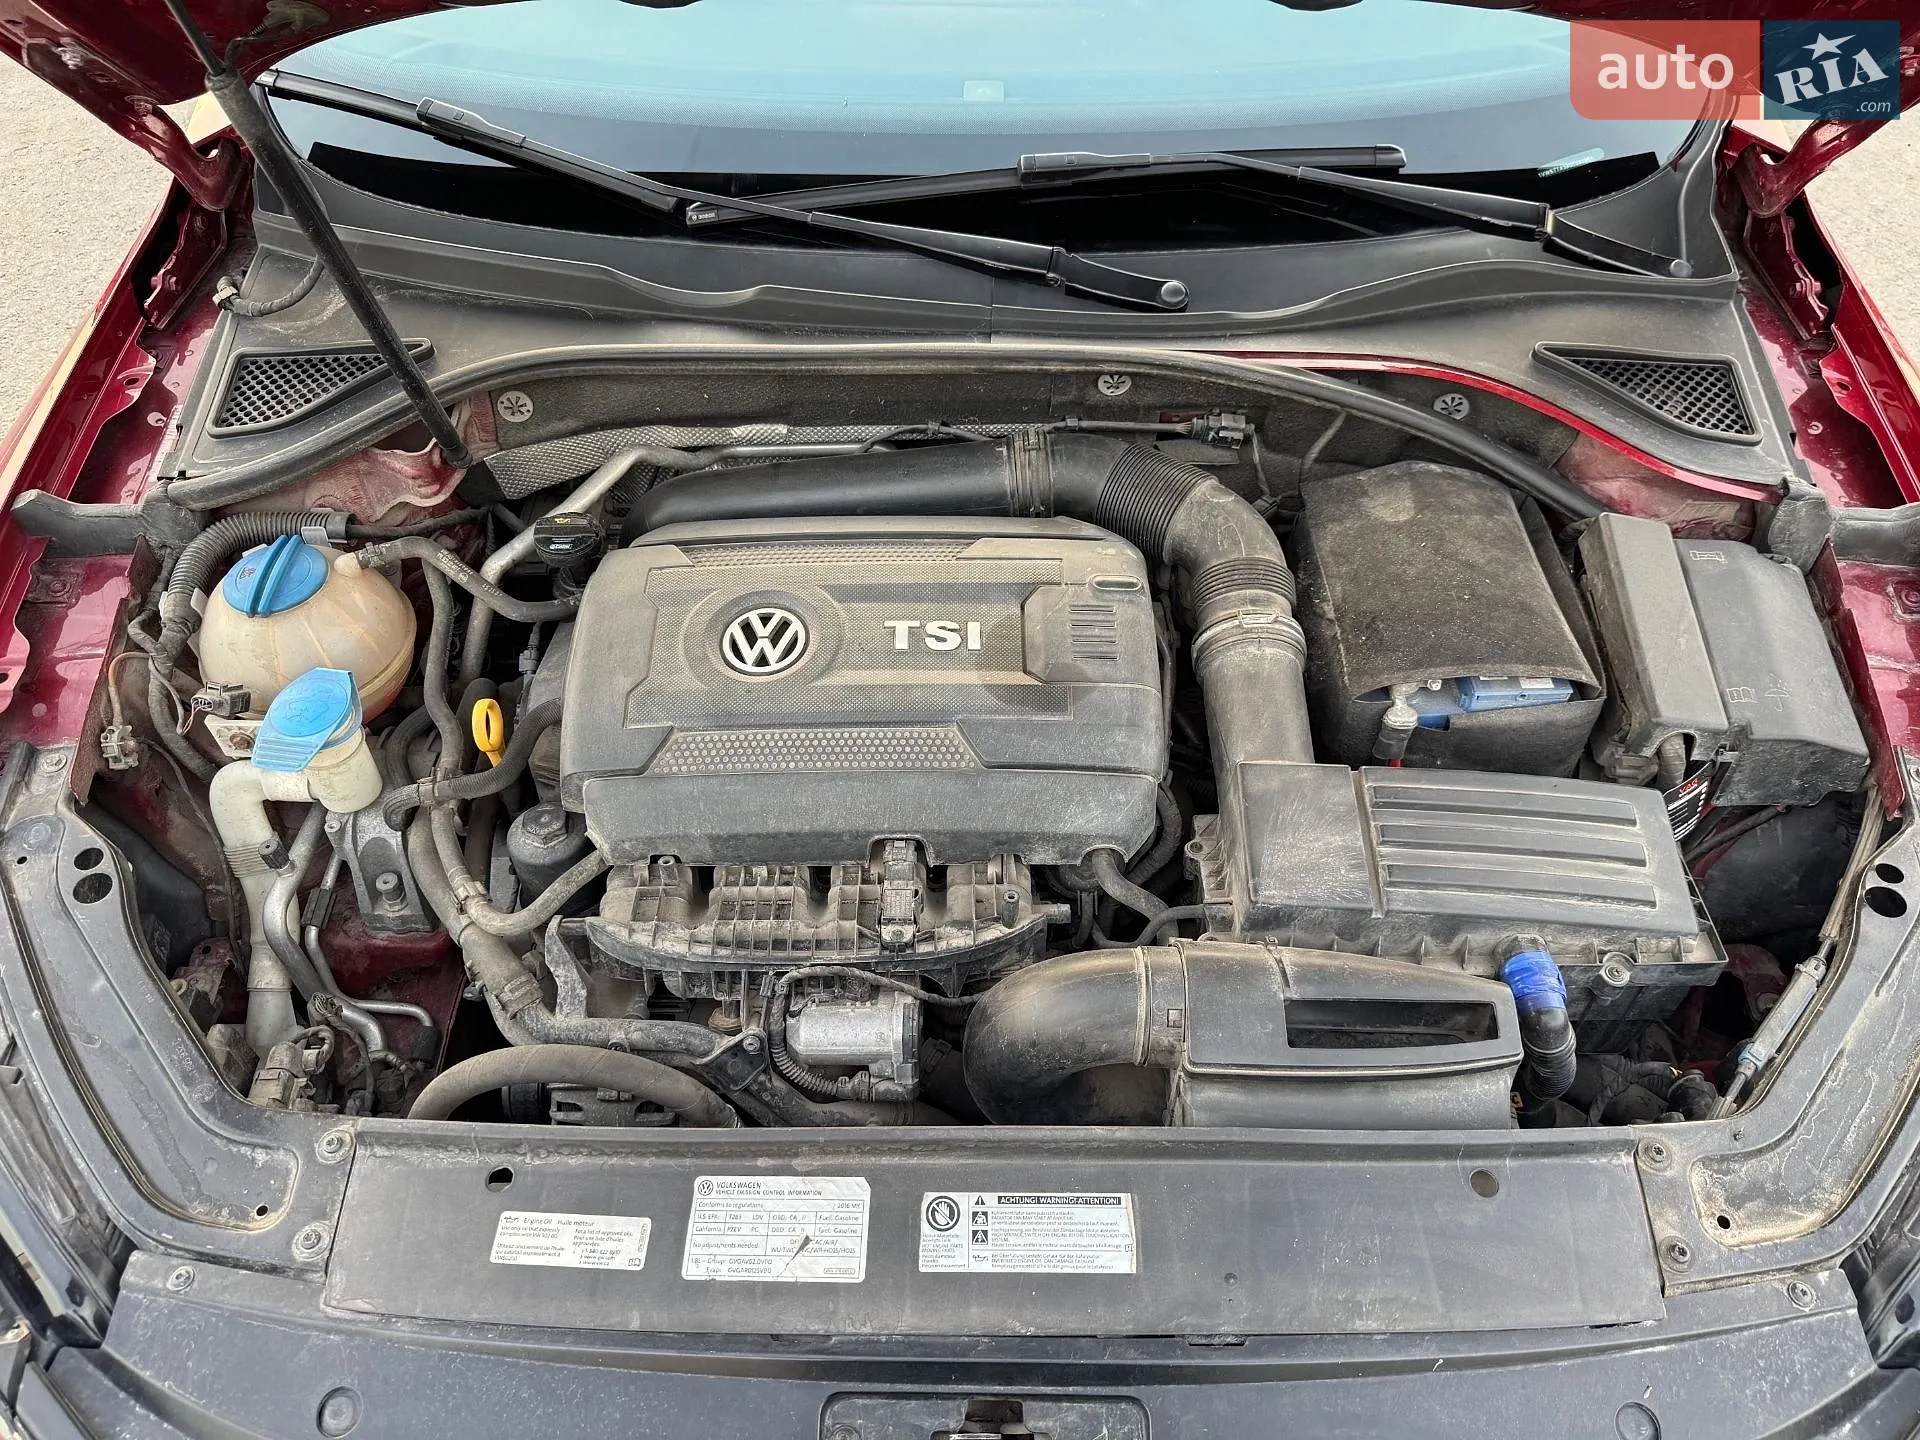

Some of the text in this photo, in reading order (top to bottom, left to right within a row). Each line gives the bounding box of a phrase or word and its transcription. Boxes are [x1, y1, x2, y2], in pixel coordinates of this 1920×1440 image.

[884, 620, 981, 652] TSI
[1000, 1196, 1038, 1204] ACHTUNG!
[523, 1217, 544, 1226] Engine
